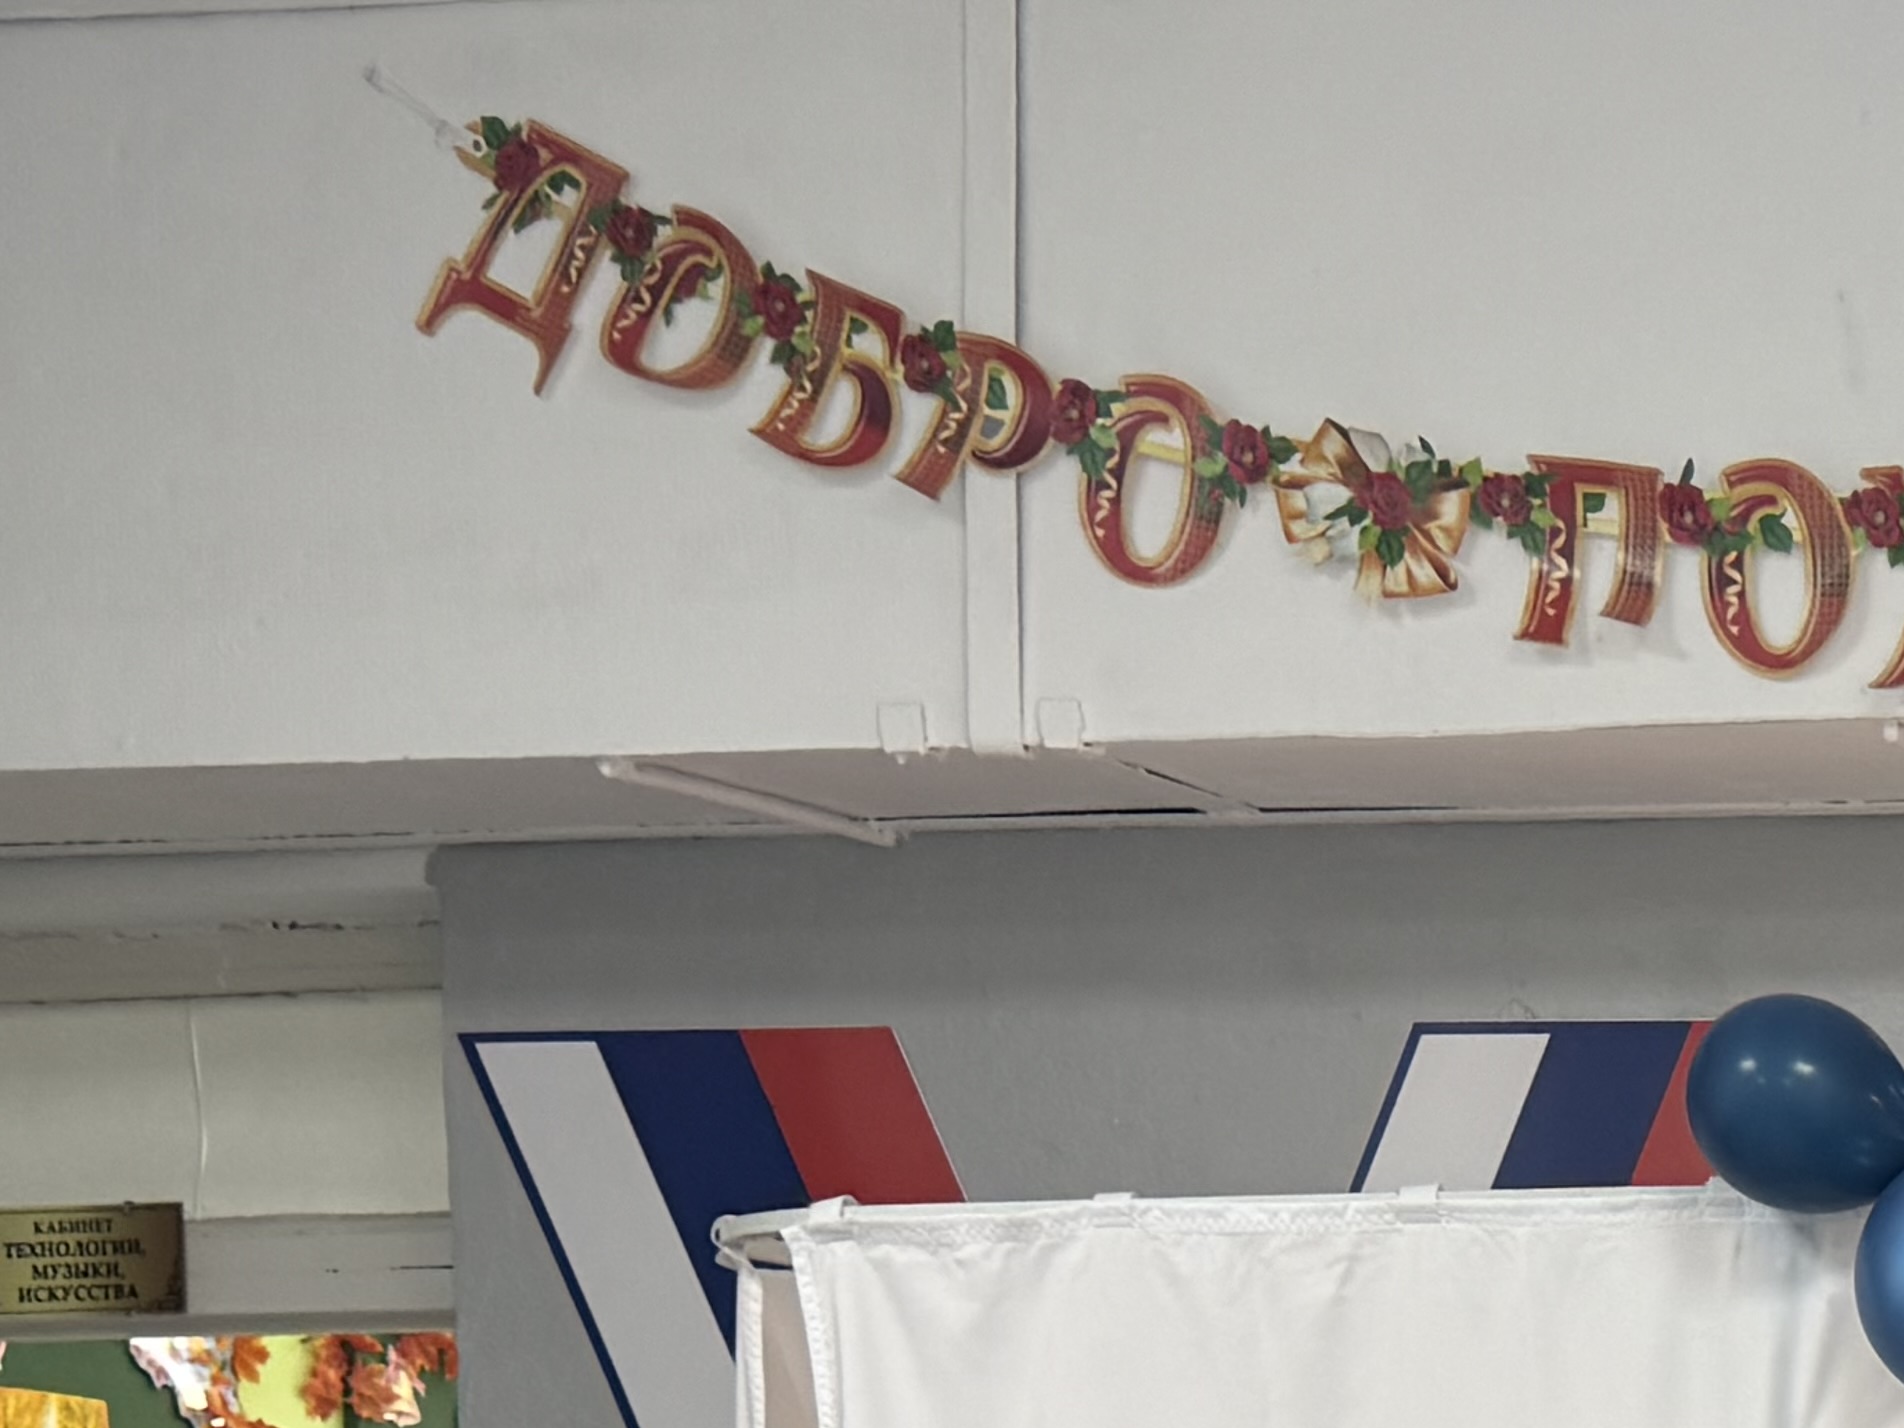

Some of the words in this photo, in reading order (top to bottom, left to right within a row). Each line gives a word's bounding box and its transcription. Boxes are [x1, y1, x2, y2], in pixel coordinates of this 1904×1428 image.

[415, 117, 1222, 588] ДОБРО
[33, 1218, 114, 1235] КАБИНЕТ
[3, 1238, 147, 1259] ТЕХНОЛОГИИ,
[32, 1262, 126, 1281] МУЗЫКИ,
[18, 1283, 140, 1304] ИСКУССТВА
